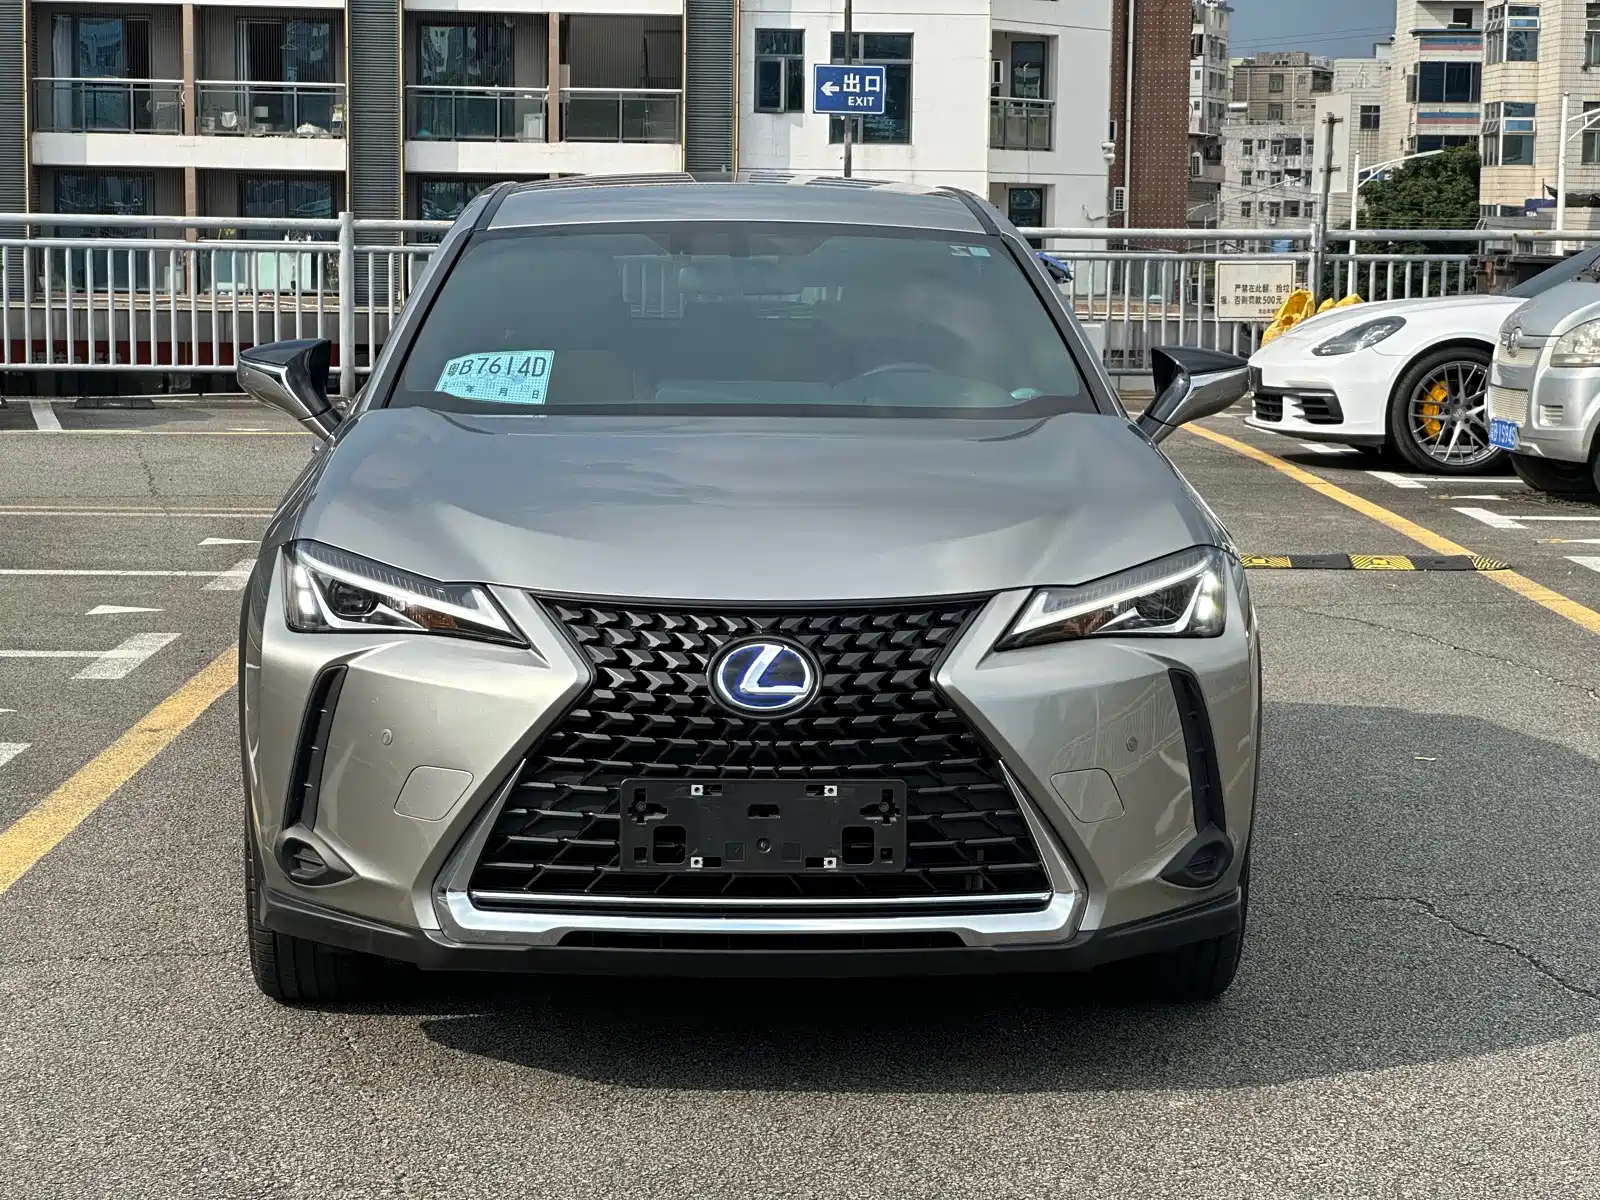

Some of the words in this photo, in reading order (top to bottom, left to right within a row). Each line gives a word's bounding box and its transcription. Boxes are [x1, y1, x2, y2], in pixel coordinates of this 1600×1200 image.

[843, 73, 880, 93] 出口
[848, 96, 875, 107] EXIT
[498, 387, 508, 397] 月
[532, 390, 540, 399] 日
